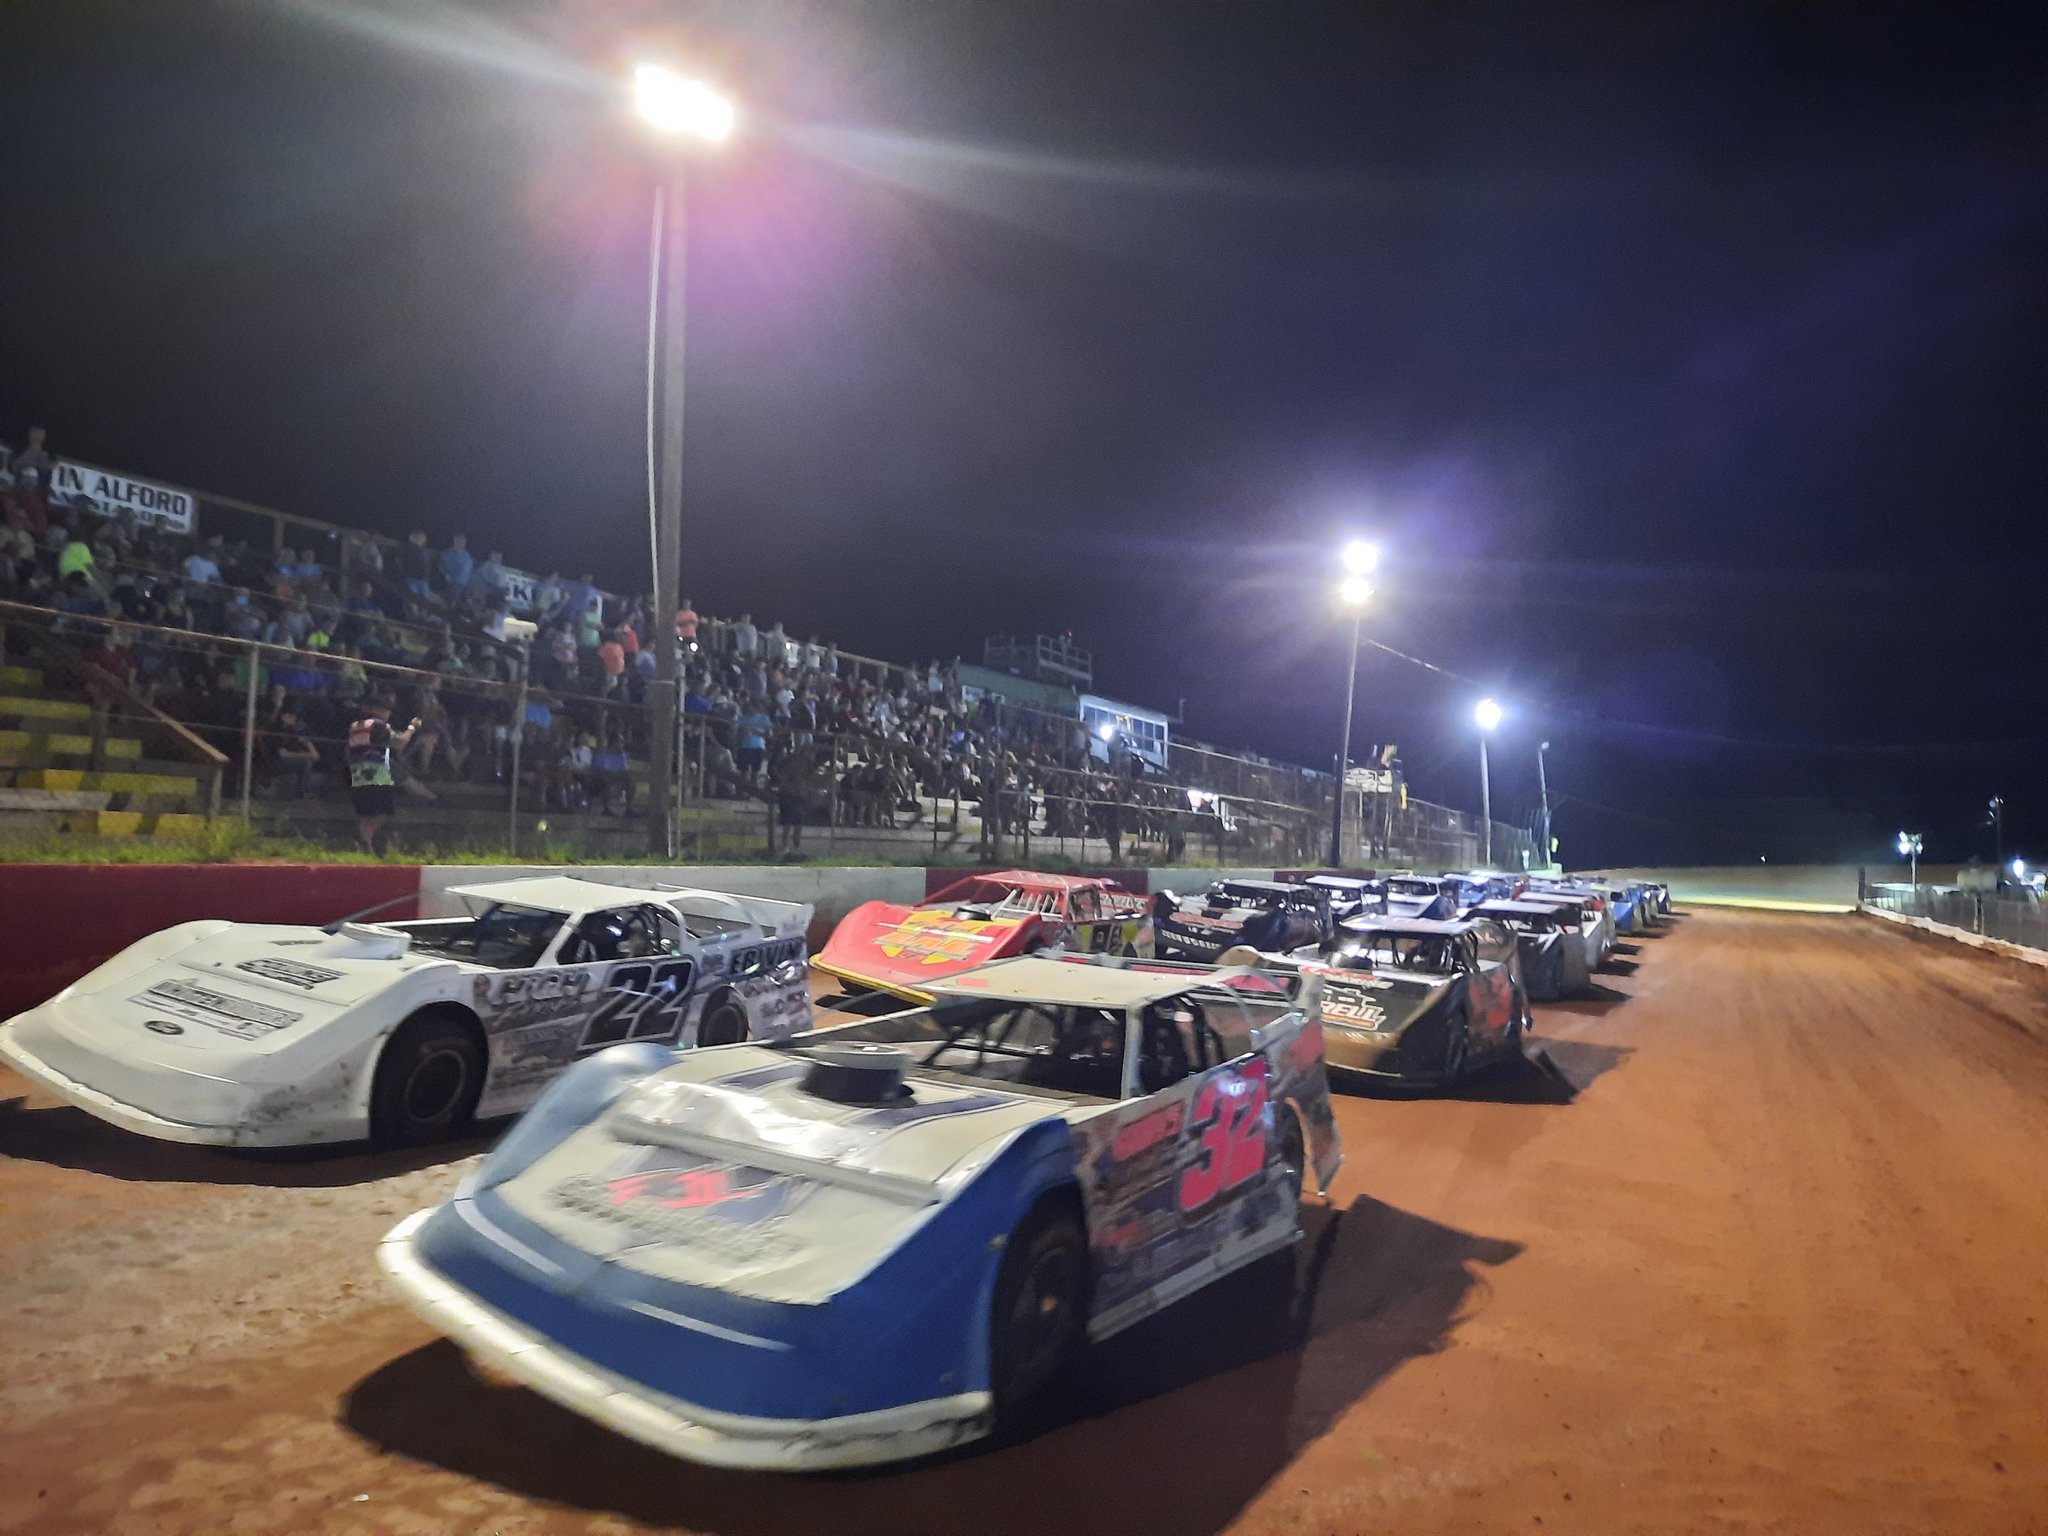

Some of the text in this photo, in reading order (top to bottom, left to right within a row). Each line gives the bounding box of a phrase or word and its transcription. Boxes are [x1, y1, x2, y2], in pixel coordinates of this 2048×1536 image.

[57, 465, 84, 492] IN
[96, 476, 188, 517] ALFORD
[579, 955, 695, 1050] 22
[1177, 1057, 1268, 1210] 32
